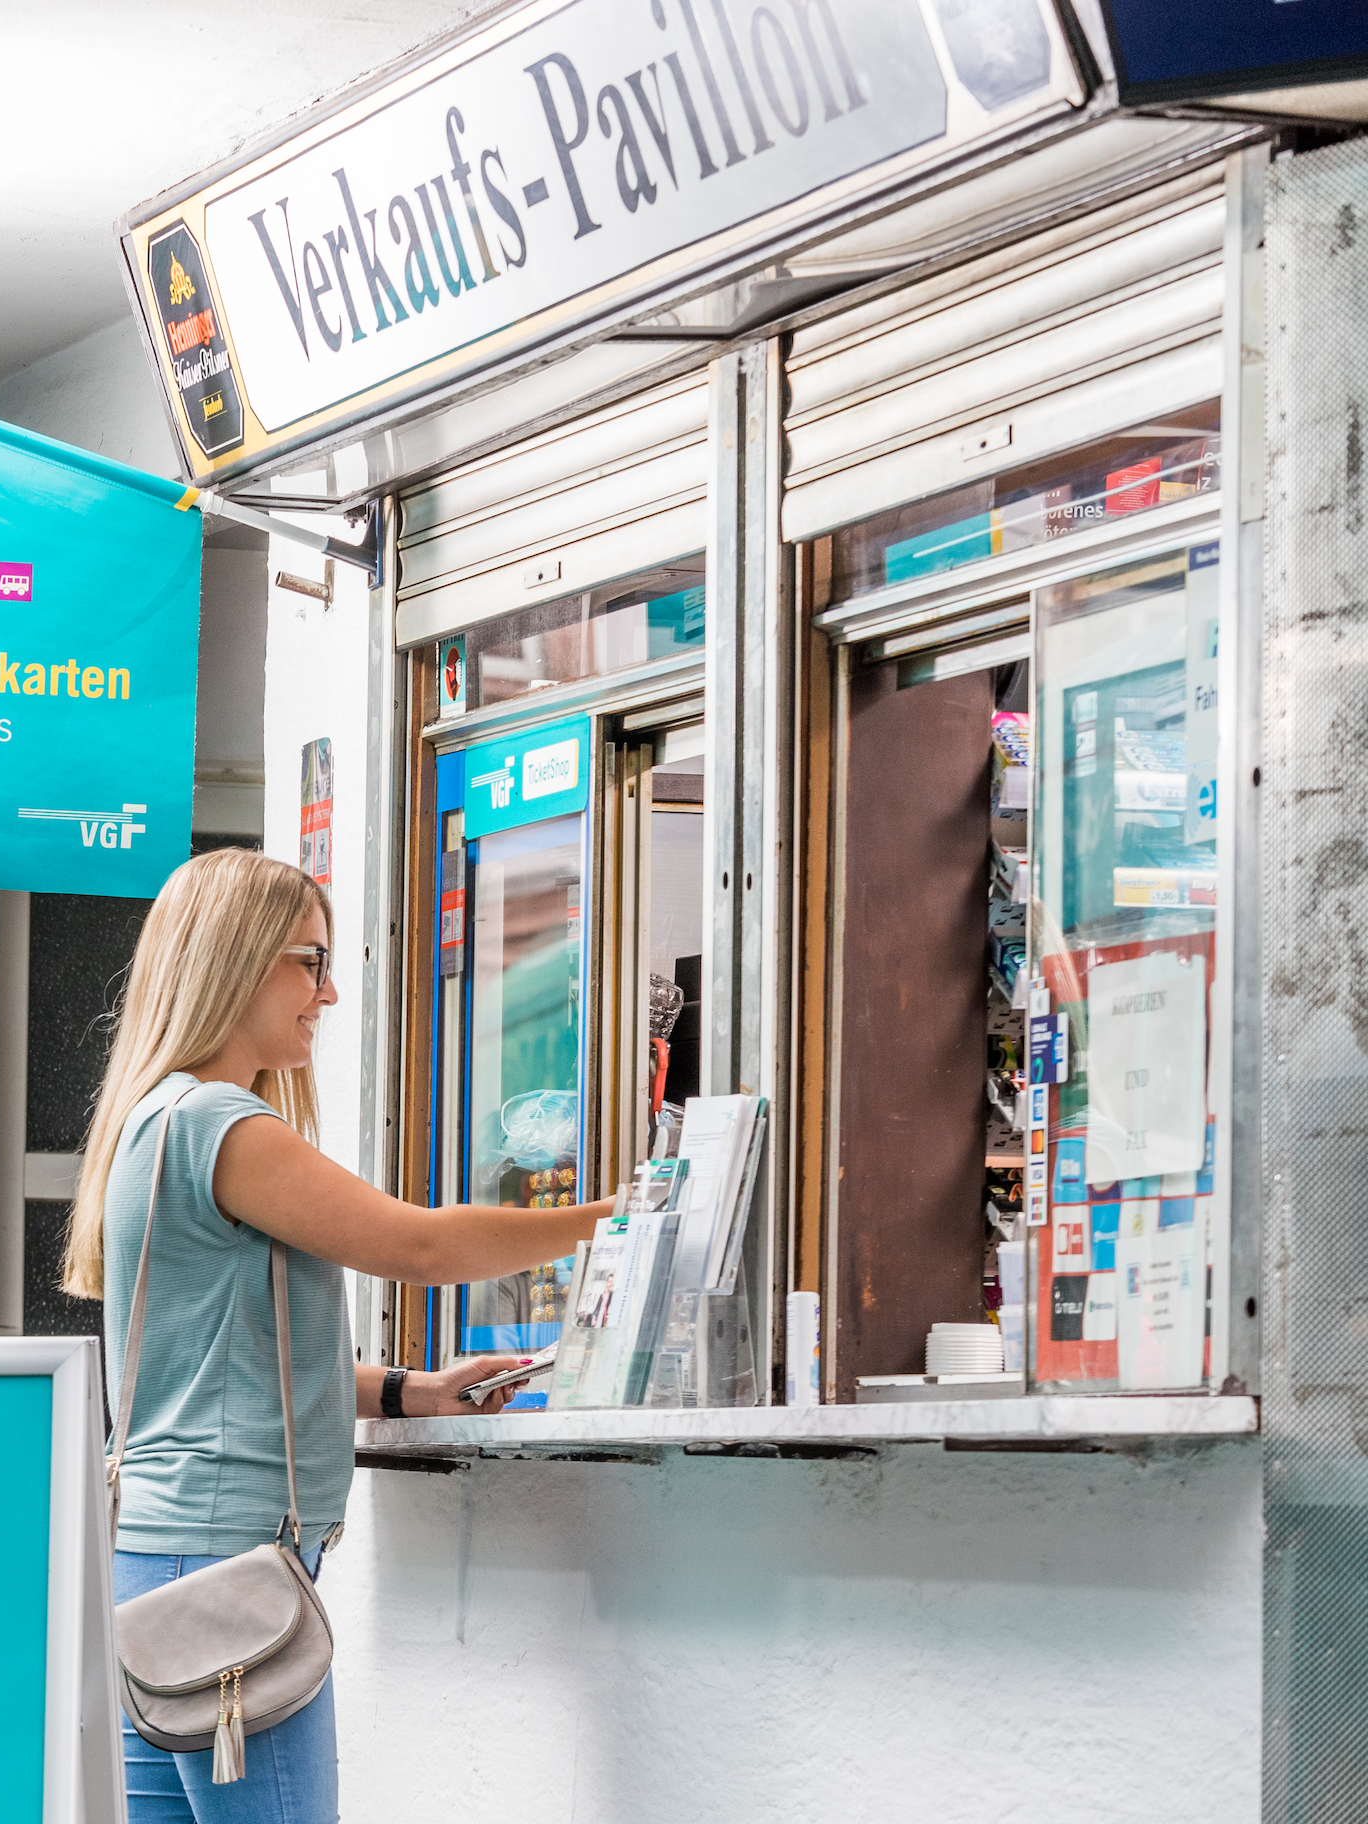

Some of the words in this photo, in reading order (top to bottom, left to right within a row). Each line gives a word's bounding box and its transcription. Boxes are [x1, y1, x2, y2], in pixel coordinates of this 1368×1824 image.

[246, 0, 868, 364] Verkaufs-Pavillon
[167, 307, 217, 356] Henninger
[528, 757, 570, 785] TicketShop
[79, 803, 147, 849] VGF
